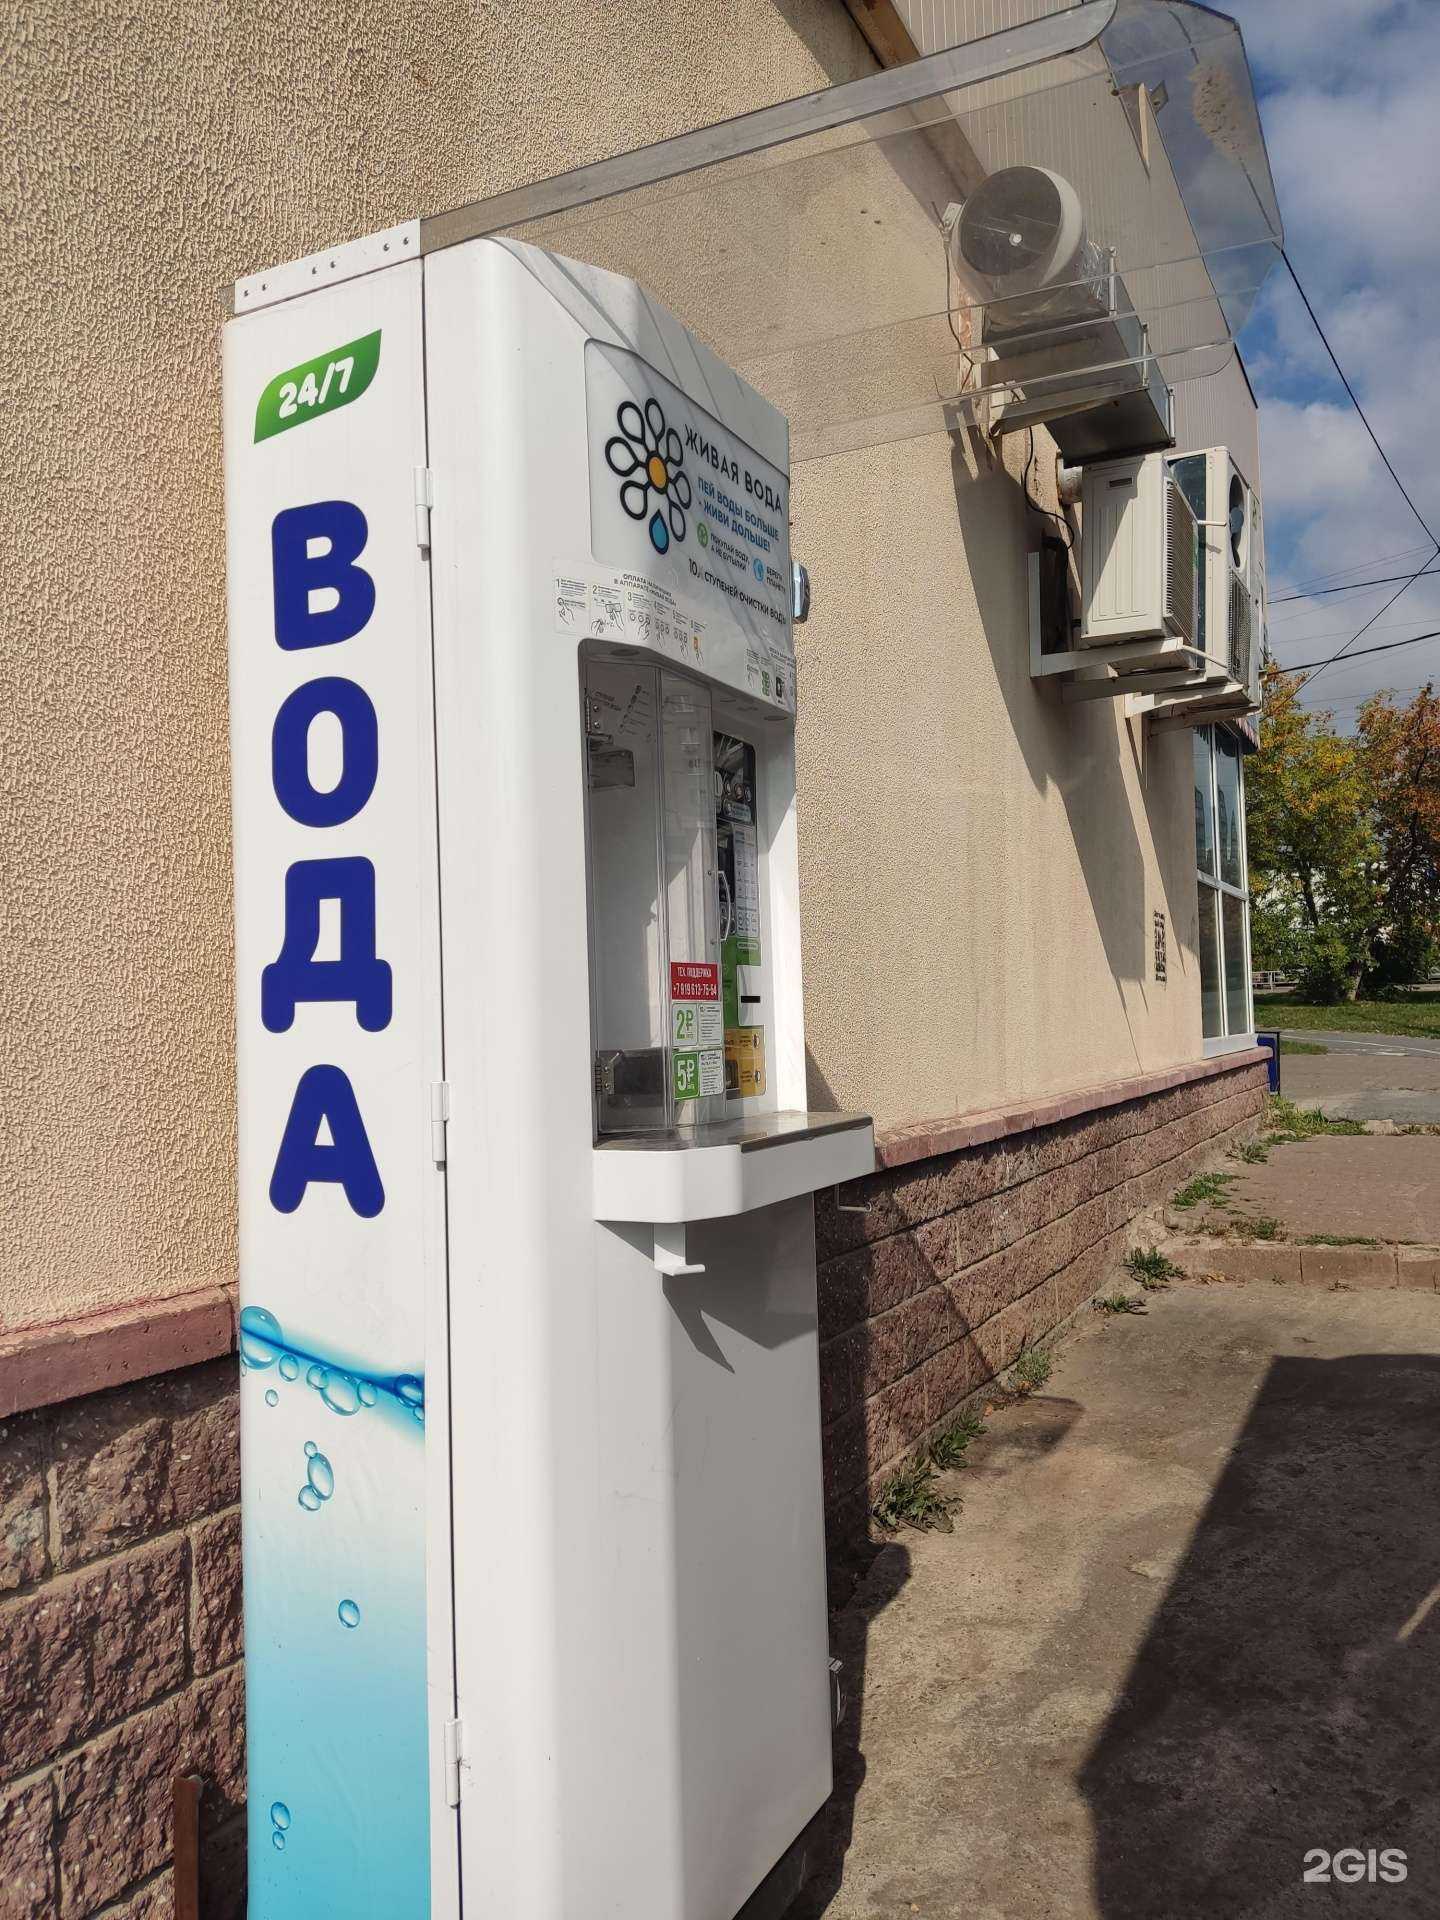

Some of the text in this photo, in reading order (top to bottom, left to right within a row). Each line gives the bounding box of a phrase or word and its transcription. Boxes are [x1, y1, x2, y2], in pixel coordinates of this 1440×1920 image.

[278, 356, 355, 419] 24/7
[684, 423, 783, 516] ЖИВАЯ ВОДА
[697, 476, 780, 541] ПЕЙ ВОДЫ БОЛЬШЕ
[703, 499, 730, 528] ЖИВИ
[592, 584, 598, 594] 2
[627, 591, 632, 601] 3
[704, 571, 738, 599] СТУПЕНЕЙ
[739, 591, 769, 616] ОЧИСТКИ
[261, 499, 393, 1218] ВОДА
